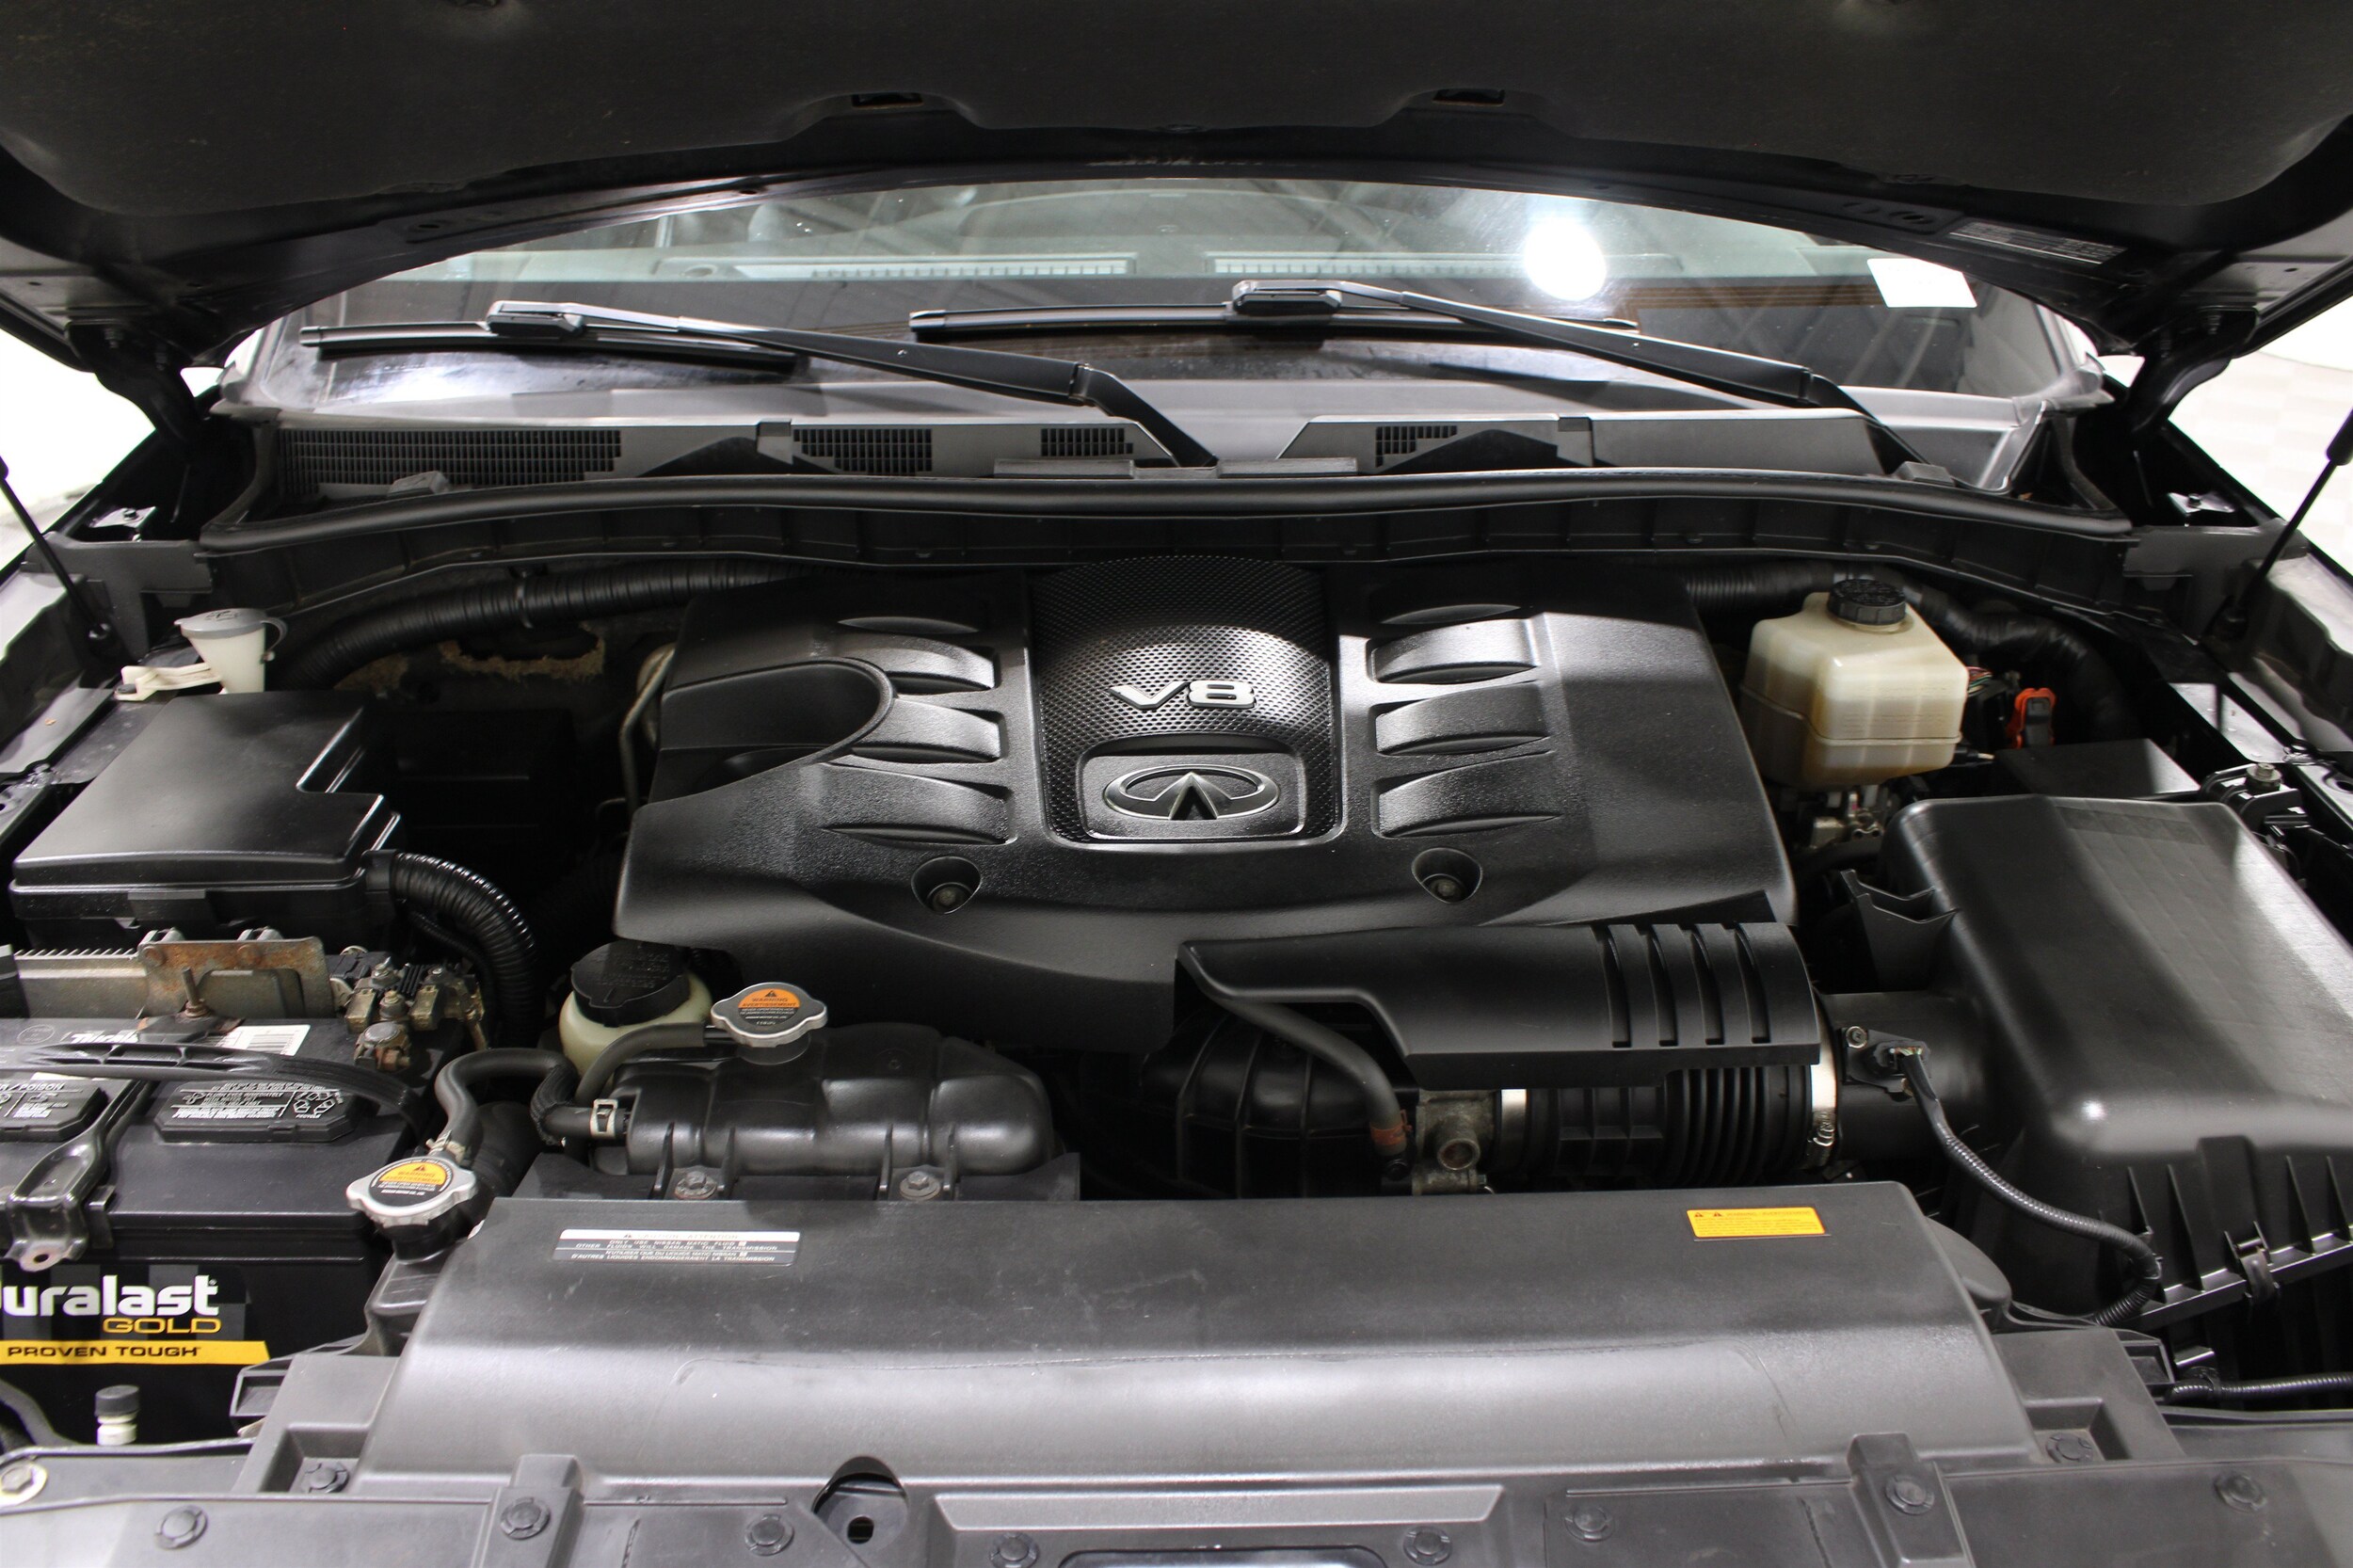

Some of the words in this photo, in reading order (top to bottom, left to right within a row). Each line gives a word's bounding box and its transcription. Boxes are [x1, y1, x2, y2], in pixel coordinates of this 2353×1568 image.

[1107, 680, 1257, 710] V8
[0, 1274, 219, 1318] uralast
[102, 1318, 222, 1334] GOLD
[8, 1346, 107, 1357] PROVEN
[115, 1346, 199, 1357] TOUGH
